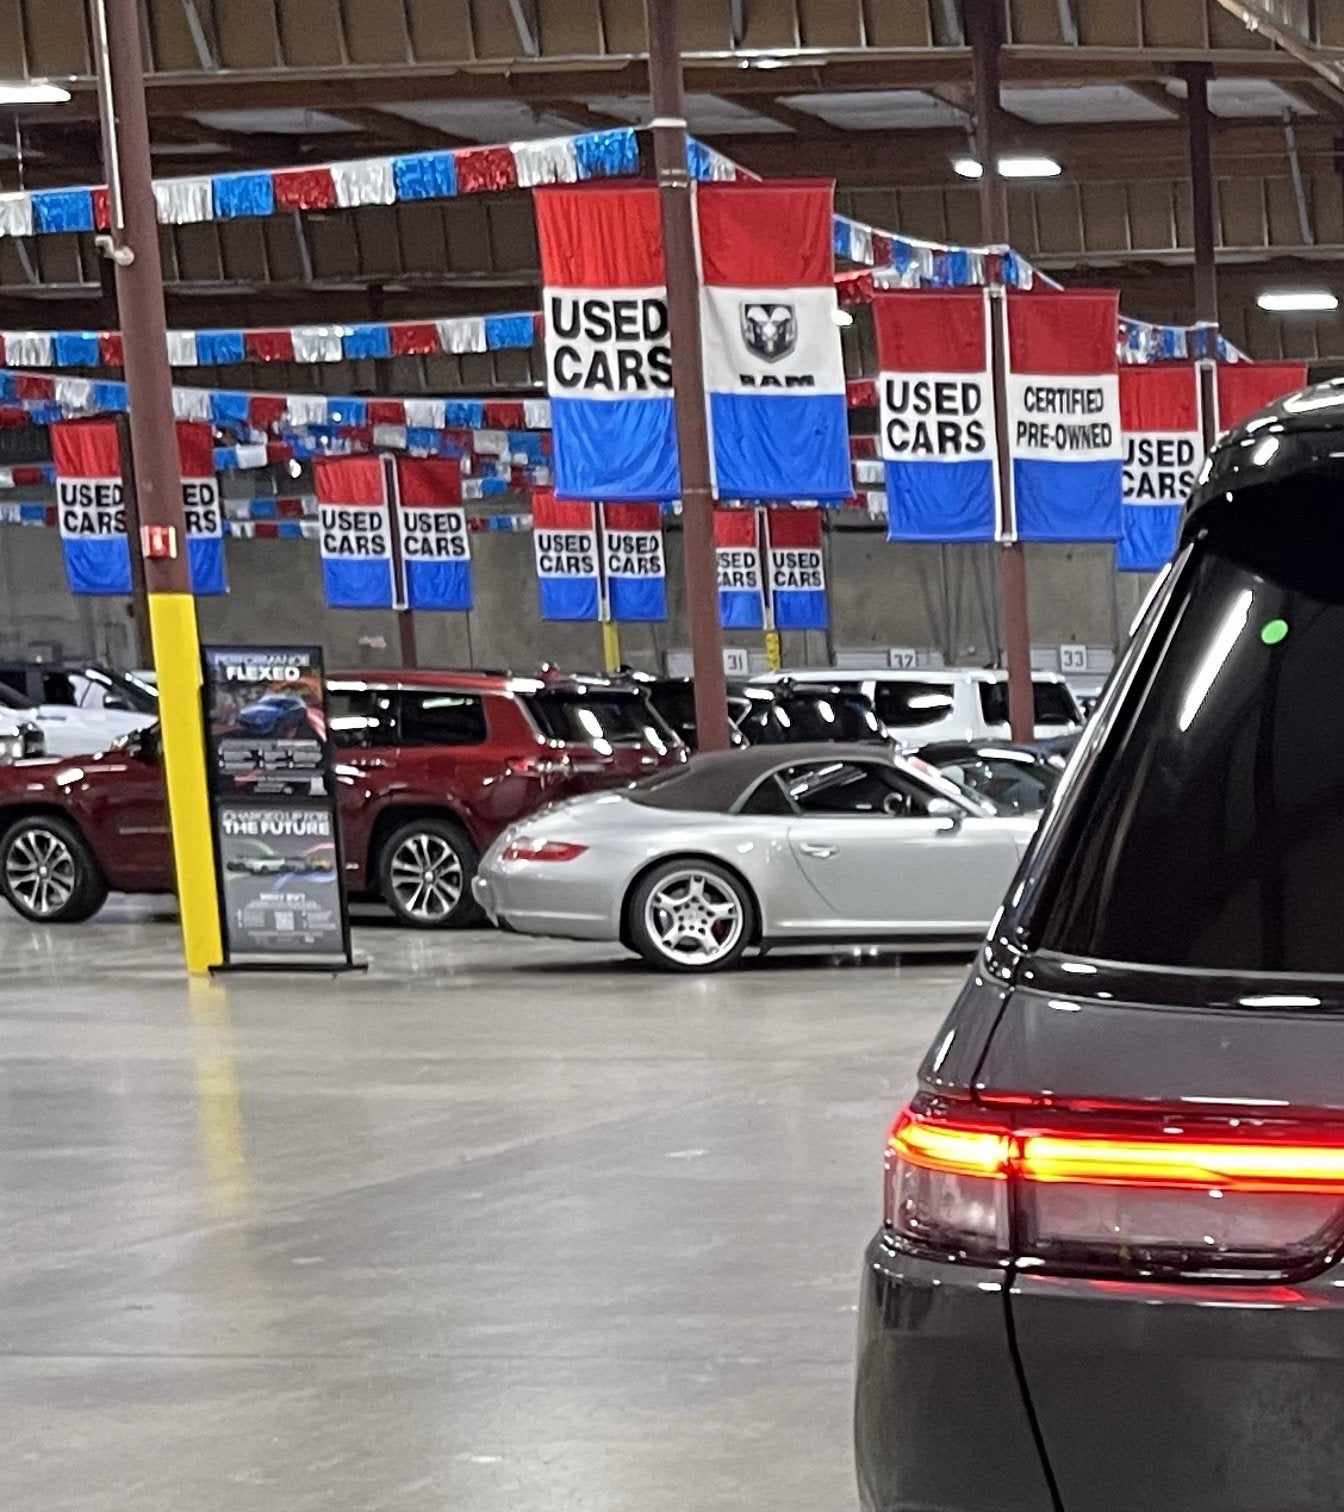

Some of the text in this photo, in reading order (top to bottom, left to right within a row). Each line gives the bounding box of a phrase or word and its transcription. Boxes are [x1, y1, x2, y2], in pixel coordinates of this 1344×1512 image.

[551, 297, 671, 343] USED
[553, 345, 673, 390] CARS
[738, 373, 815, 387] RAM
[885, 379, 982, 416] USED
[1023, 386, 1103, 414] CERTIFIED
[886, 418, 986, 455] CARS
[1016, 421, 1112, 450] PRE-OWNED
[60, 483, 123, 507] USED
[63, 510, 126, 533] CARS
[322, 510, 383, 532] USED
[404, 512, 462, 533] USED
[323, 534, 386, 555] CARS
[404, 536, 466, 556] CARS
[538, 534, 592, 553] USED
[608, 535, 659, 554] USED
[539, 555, 594, 573] CARS
[608, 555, 662, 574] CARS
[719, 552, 756, 569] SED
[772, 552, 820, 569] USED
[773, 571, 822, 588] CARS
[727, 655, 743, 670] 31
[1064, 650, 1084, 667] 33
[226, 666, 300, 681] FLEXED
[223, 821, 330, 836] THE FUTURE
